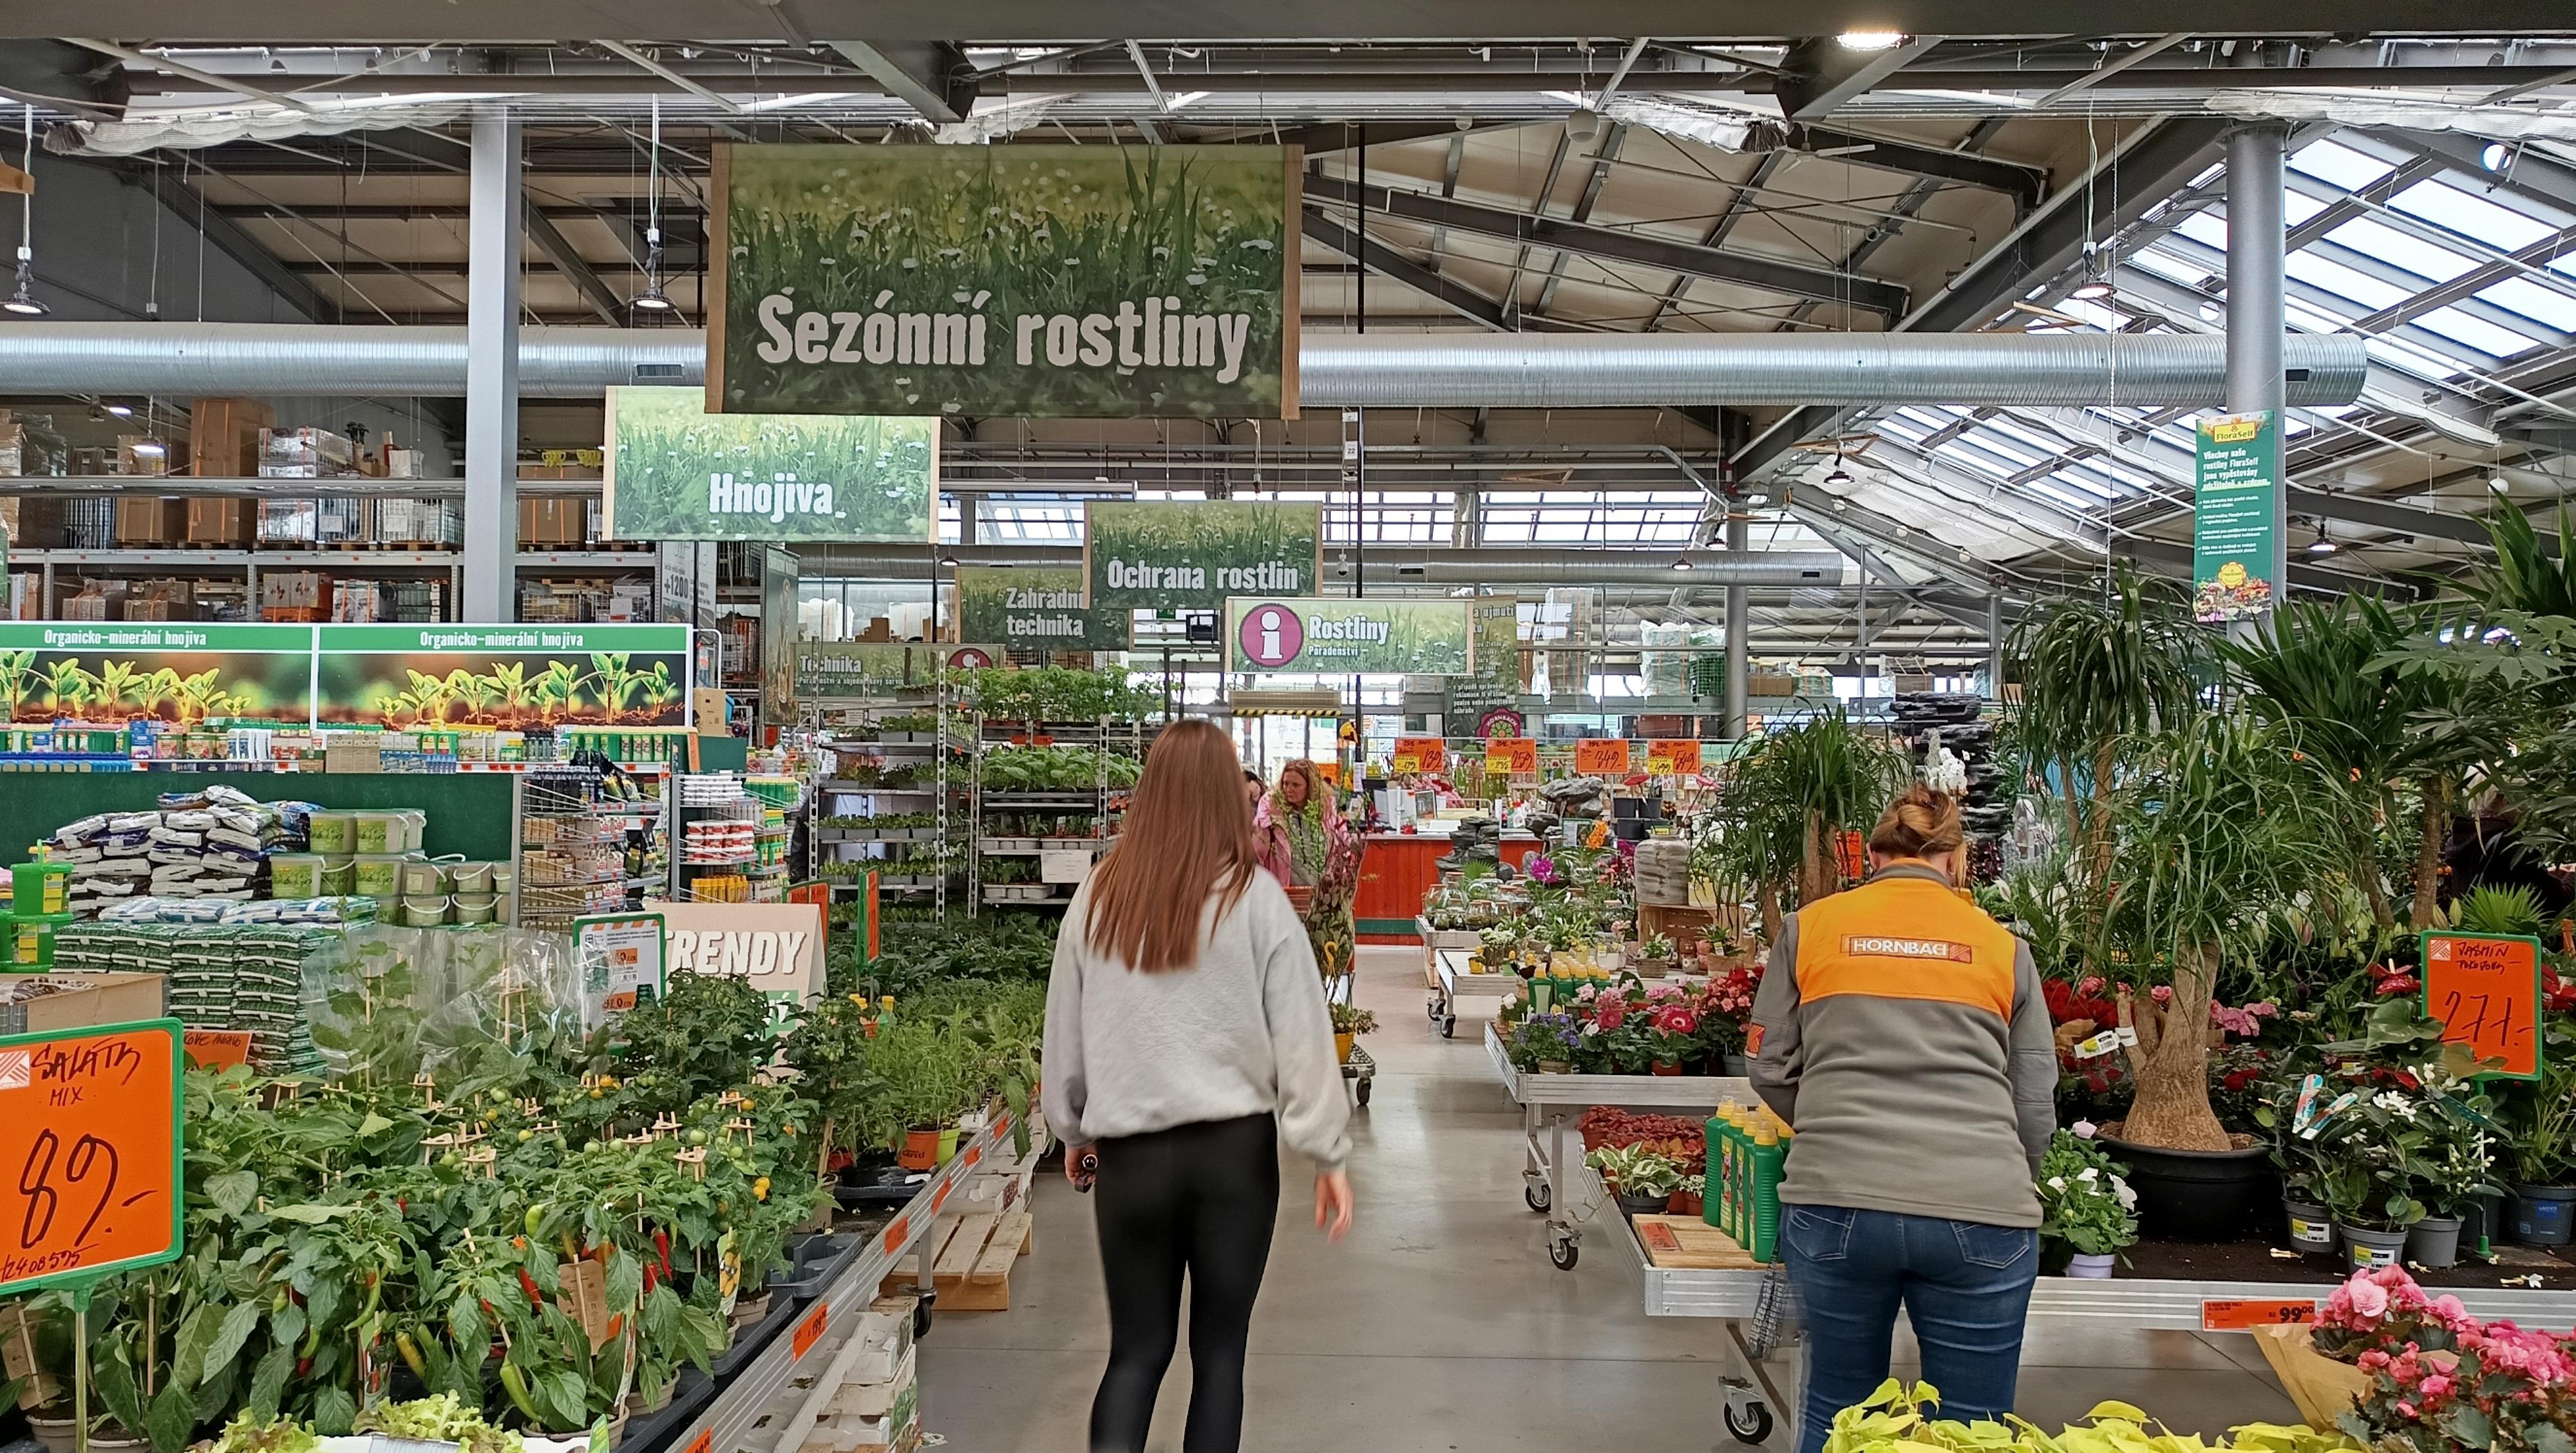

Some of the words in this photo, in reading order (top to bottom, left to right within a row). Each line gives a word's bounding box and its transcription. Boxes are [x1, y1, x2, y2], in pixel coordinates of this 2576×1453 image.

[757, 290, 992, 365] Sezónní
[1016, 296, 1250, 384] rostliny
[2217, 430, 2254, 440] FloraSelf
[2230, 457, 2259, 467] FloraSelf
[709, 473, 833, 523] Hnojiva
[1108, 559, 1205, 589] Ochrana
[1217, 560, 1298, 590] rostlin
[1482, 604, 1515, 620] ujmutí
[1006, 614, 1084, 636] technika
[1308, 616, 1389, 645] Rostliny
[44, 629, 162, 647] Organicko-minerální
[165, 629, 207, 648] hnojiva
[420, 631, 538, 649] Organicko-minerální
[542, 631, 583, 649] hnojiva
[1308, 645, 1359, 656] Poradenství
[1486, 714, 1517, 726] HORNBACH
[49, 1086, 84, 1106] MIX
